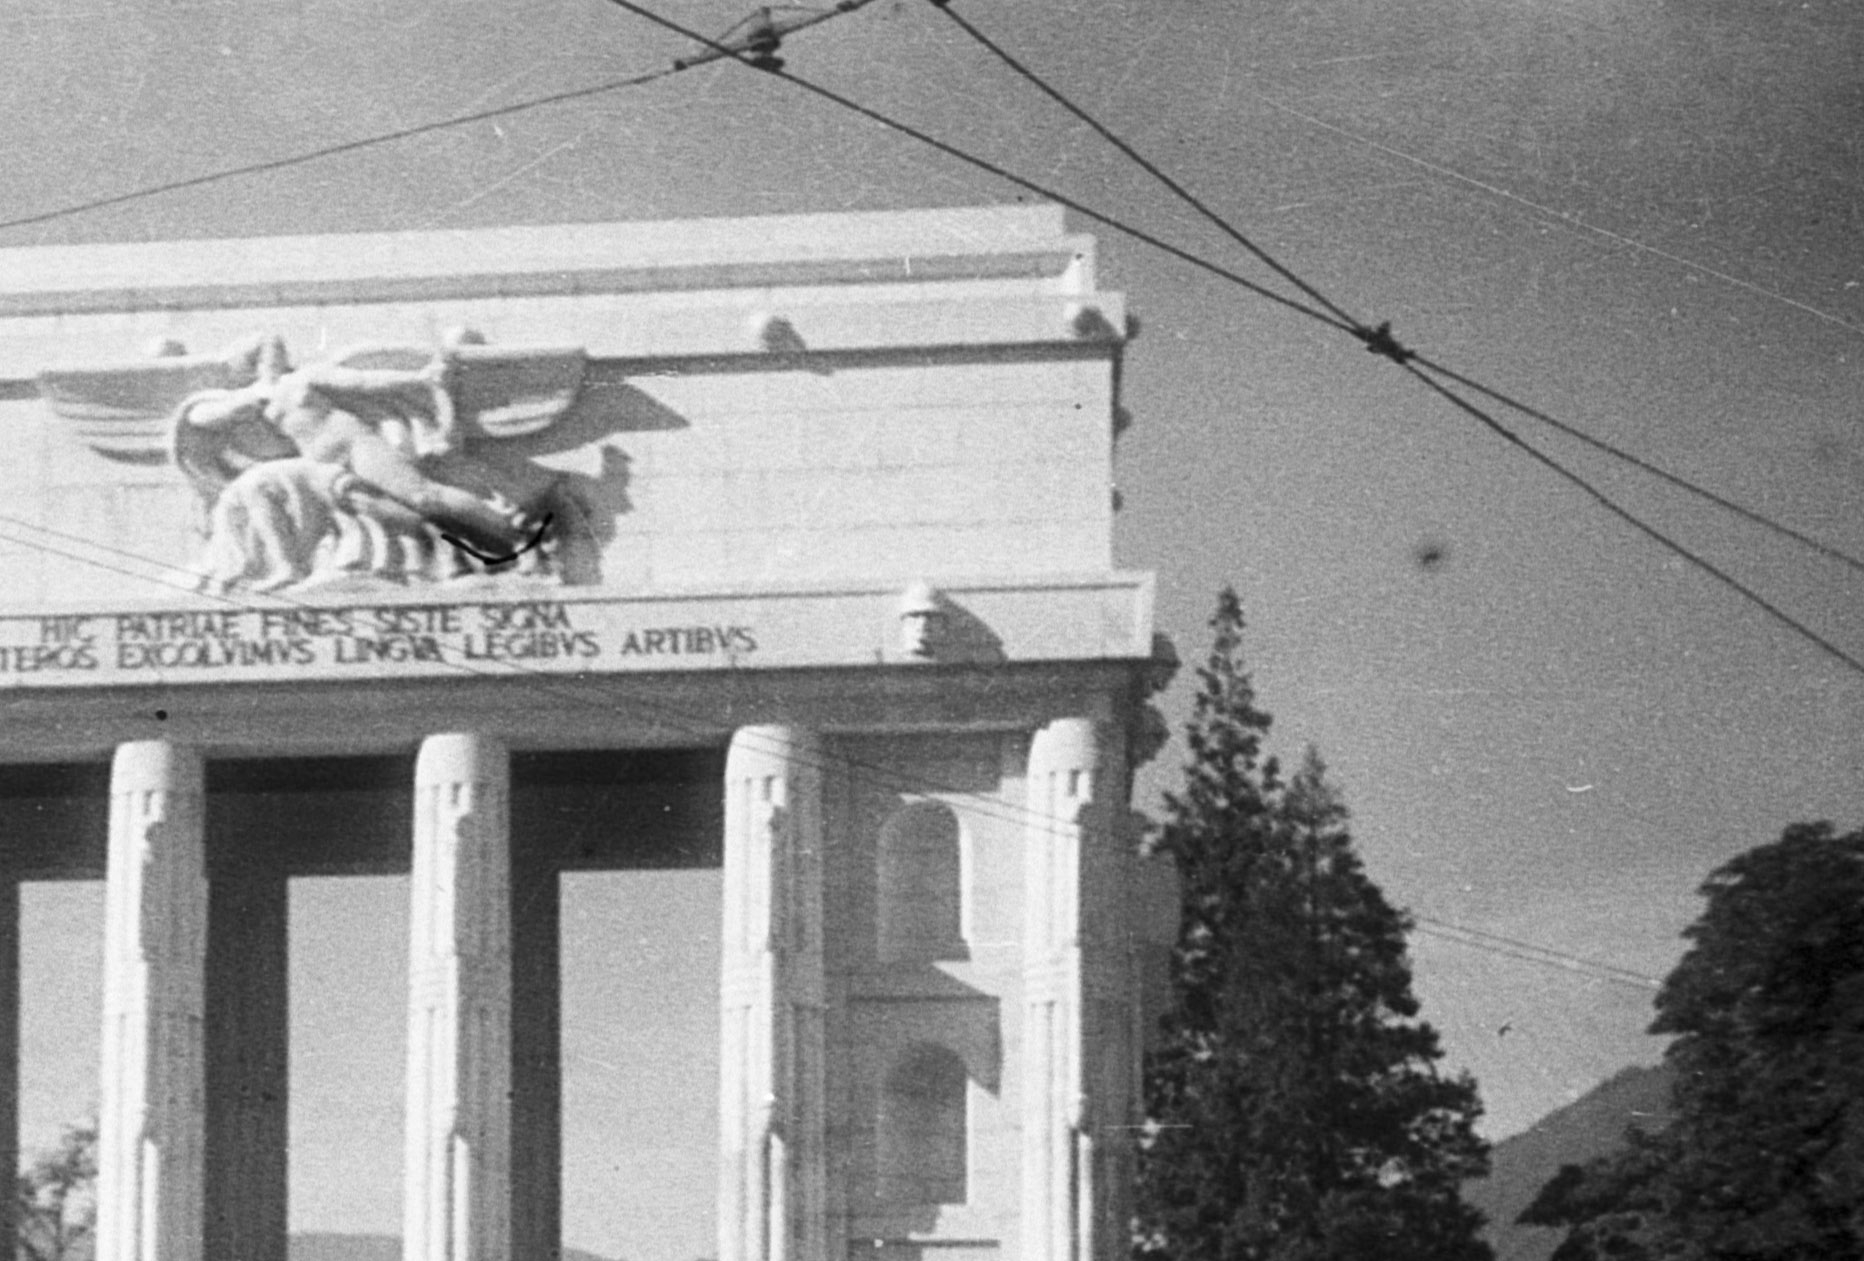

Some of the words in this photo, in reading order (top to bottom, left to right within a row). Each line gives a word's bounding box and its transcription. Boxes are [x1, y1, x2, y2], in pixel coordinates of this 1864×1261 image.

[40, 616, 94, 643] HIC
[117, 613, 240, 641] PATRIAE
[262, 610, 353, 638] FINES
[376, 606, 462, 633] SISTE
[482, 601, 572, 630] SIGNA
[334, 634, 444, 663] LINGVA
[465, 630, 601, 660] LEGIBVS
[621, 626, 758, 656] ARTIBVS
